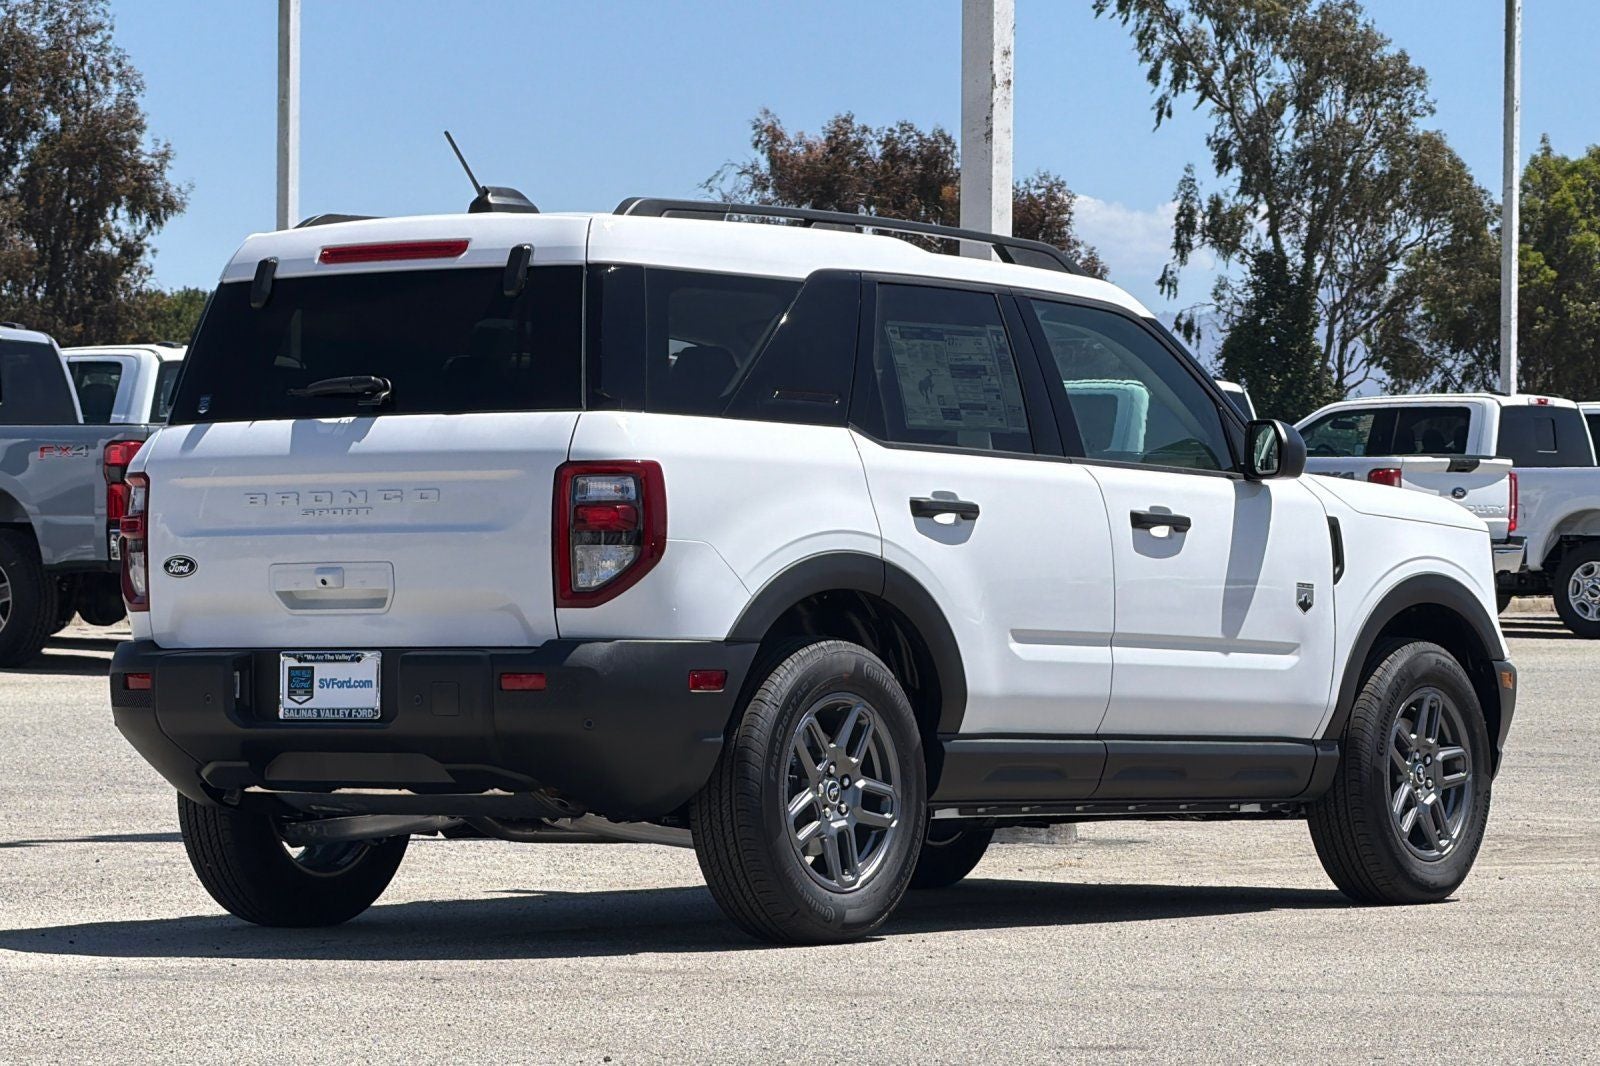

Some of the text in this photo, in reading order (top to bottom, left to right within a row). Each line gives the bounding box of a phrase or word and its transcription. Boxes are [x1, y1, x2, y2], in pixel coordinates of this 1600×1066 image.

[39, 445, 88, 460] FX4
[244, 488, 440, 506] BRONCO
[301, 506, 374, 516] SPORT
[169, 559, 190, 573] Ford
[318, 677, 373, 689] SVFord.com
[284, 709, 374, 718] SALINAS VALLEY FORD
